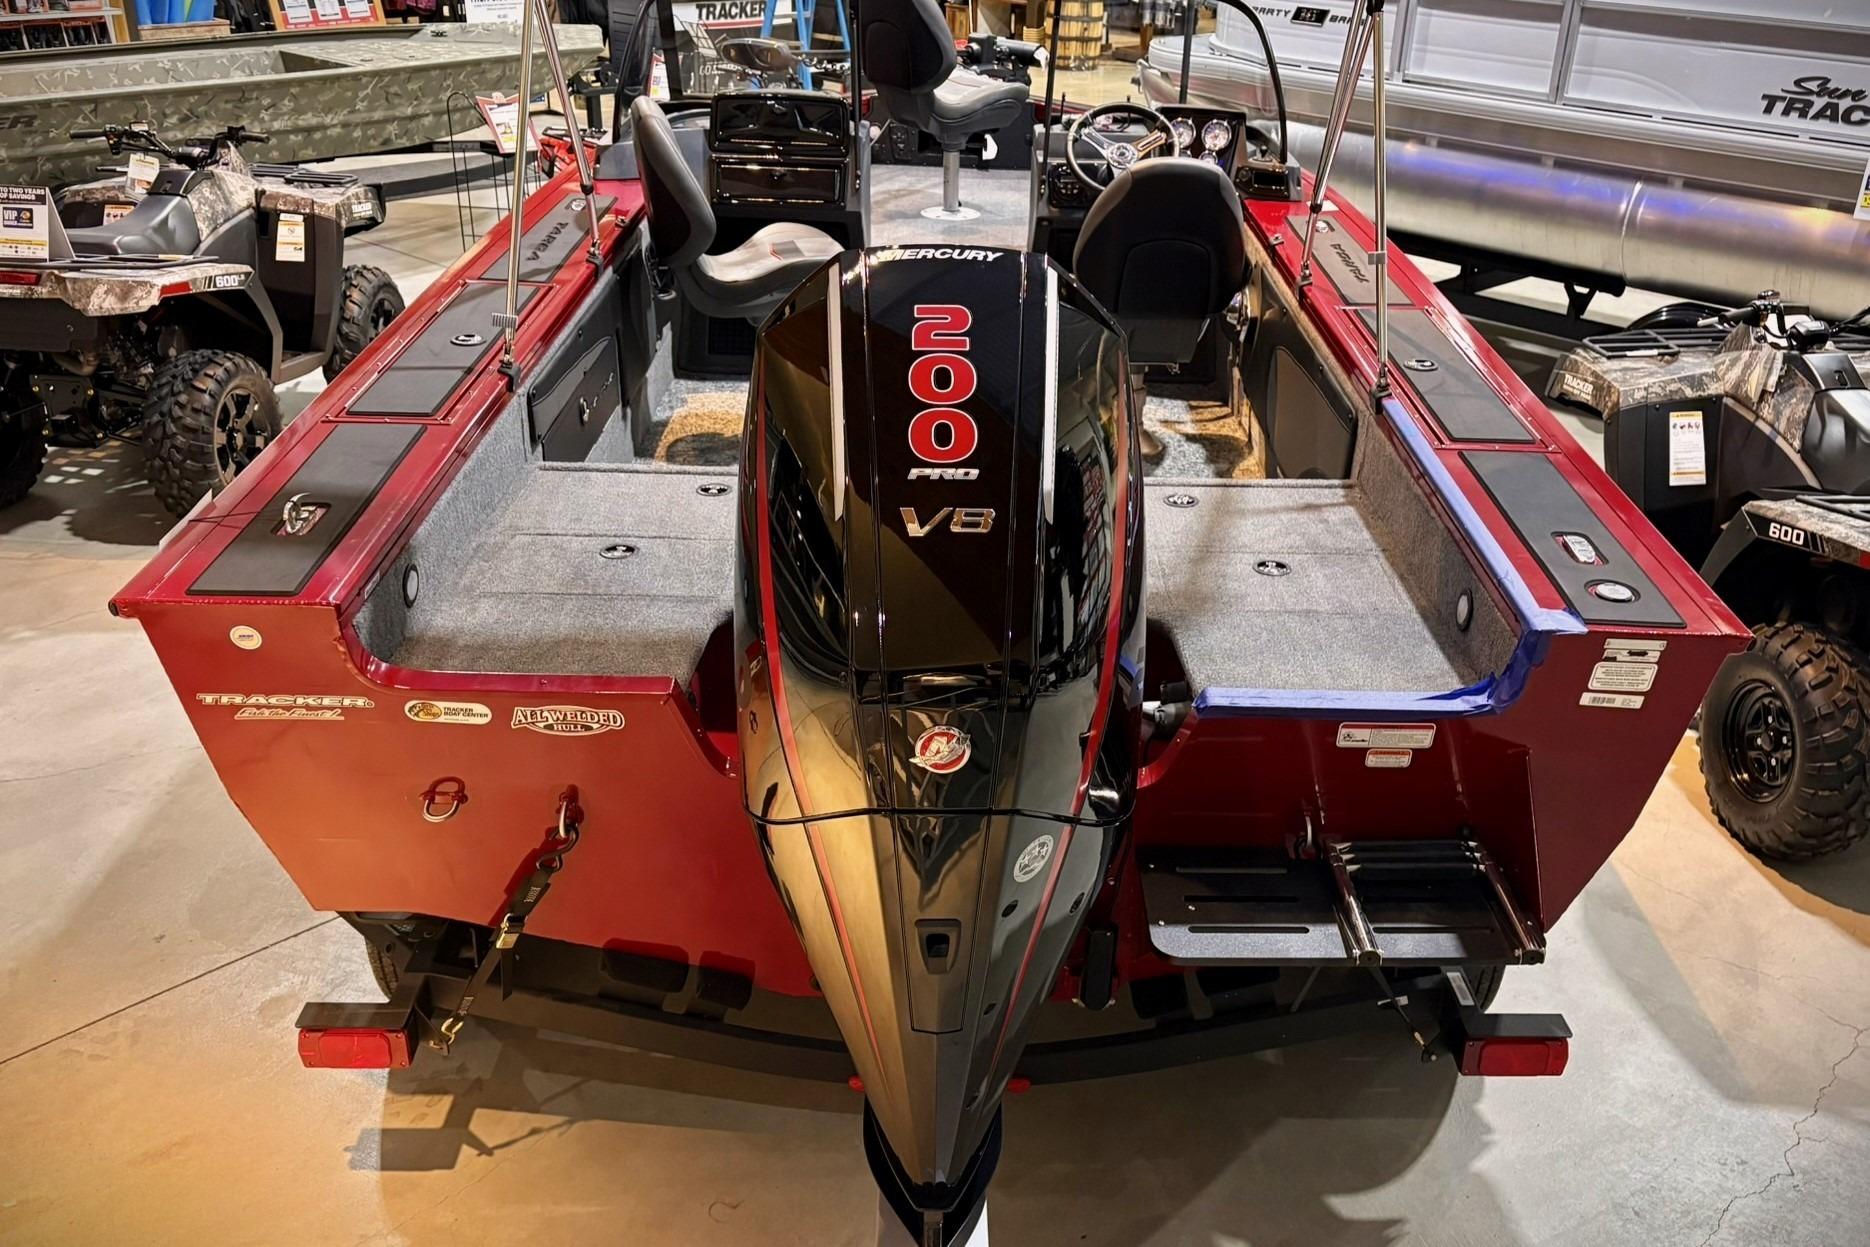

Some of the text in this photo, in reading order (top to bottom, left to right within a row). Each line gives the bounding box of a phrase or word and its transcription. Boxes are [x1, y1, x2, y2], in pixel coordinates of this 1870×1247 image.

[696, 2, 765, 21] TRACKER
[1781, 76, 1869, 102] Sun
[1761, 94, 1870, 126] TRAC
[4, 209, 17, 220] VIP
[877, 248, 1004, 262] MERCURY
[908, 304, 979, 464] 200
[1564, 374, 1594, 394] TRACKER
[907, 468, 980, 481] PRO
[900, 507, 996, 537] V8
[1769, 522, 1805, 545] 600
[198, 693, 368, 708] TRACKER
[269, 708, 287, 717] the
[514, 708, 622, 727] ALL WELDED
[553, 723, 585, 732] HULL
